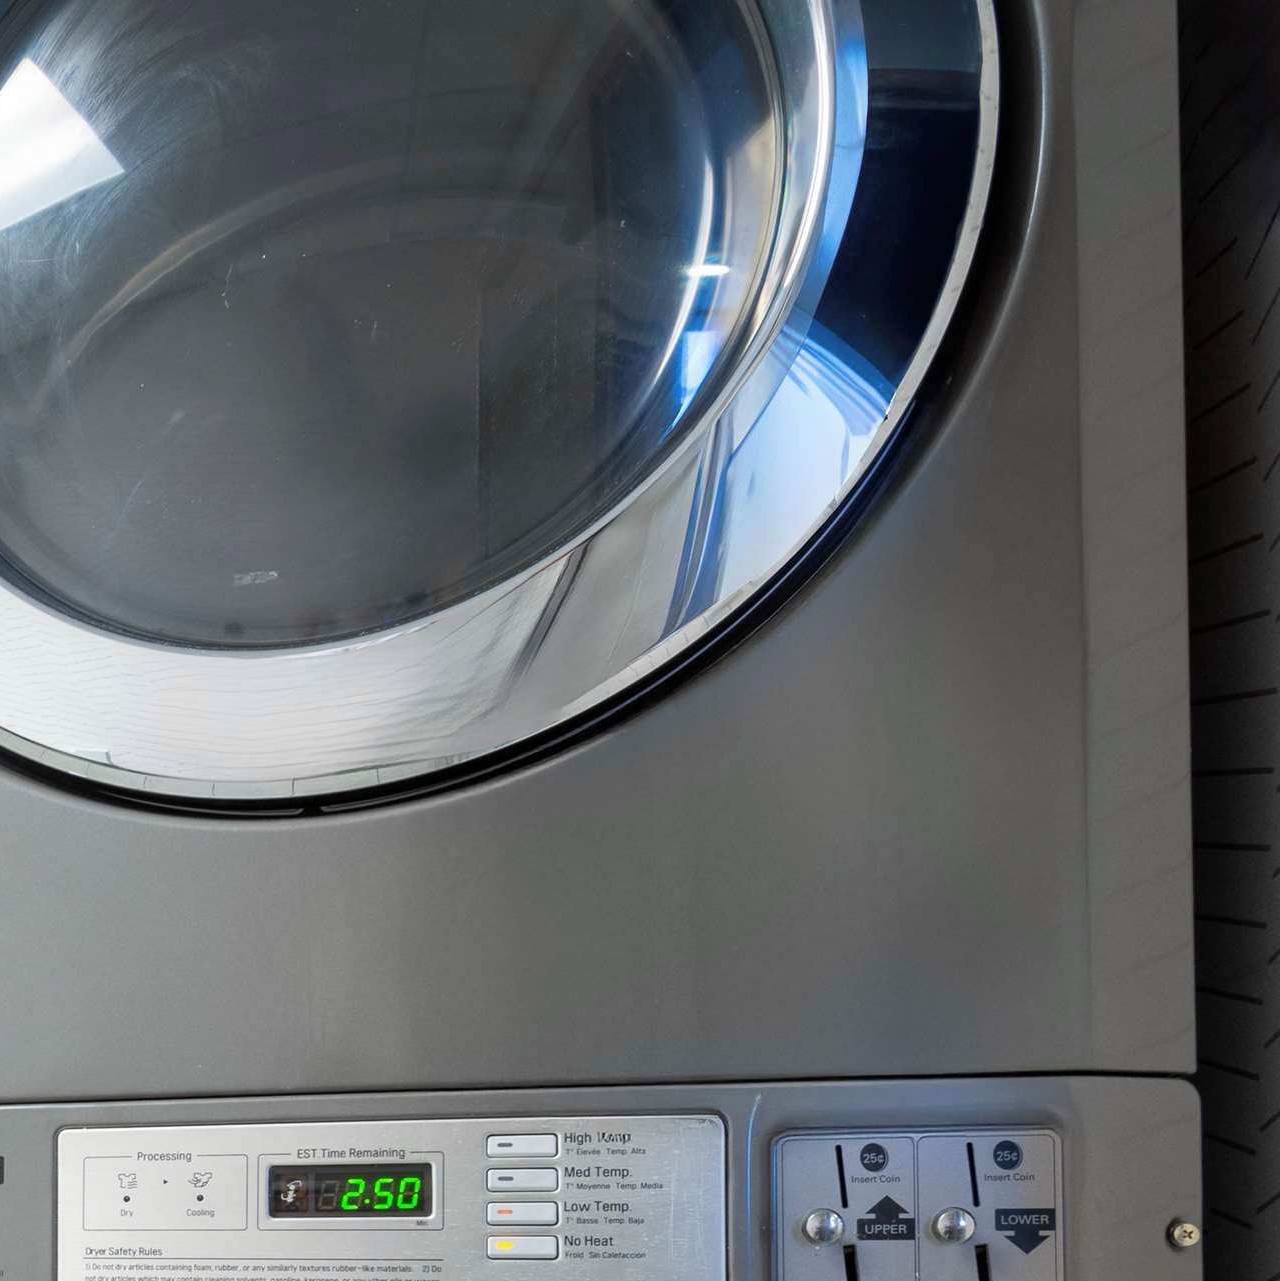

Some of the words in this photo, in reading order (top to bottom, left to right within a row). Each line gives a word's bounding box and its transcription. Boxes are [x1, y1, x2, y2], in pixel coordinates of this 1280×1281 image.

[564, 1132, 592, 1145] High
[137, 1151, 192, 1163] Processing
[349, 1148, 405, 1159] Remaining
[863, 1153, 885, 1164] 25¢
[996, 1151, 1018, 1161] 25¢
[564, 1167, 590, 1177] Med
[595, 1167, 633, 1179] Temp.
[984, 1173, 1010, 1182] Insert
[1013, 1173, 1035, 1181] Coin
[851, 1175, 877, 1183] Insert
[879, 1175, 900, 1183] Coin
[341, 1177, 421, 1210] 2.50
[564, 1201, 590, 1212] Low
[594, 1201, 632, 1213] Temp.
[120, 1209, 133, 1218] Dry
[186, 1208, 215, 1218] Cooling
[1001, 1215, 1050, 1225] LOWER
[865, 1224, 907, 1235] UPPER
[564, 1235, 580, 1246] No
[584, 1235, 613, 1246] Heat
[85, 1247, 106, 1256] Dryer
[108, 1247, 136, 1257] Safety
[138, 1247, 163, 1256] Rules
